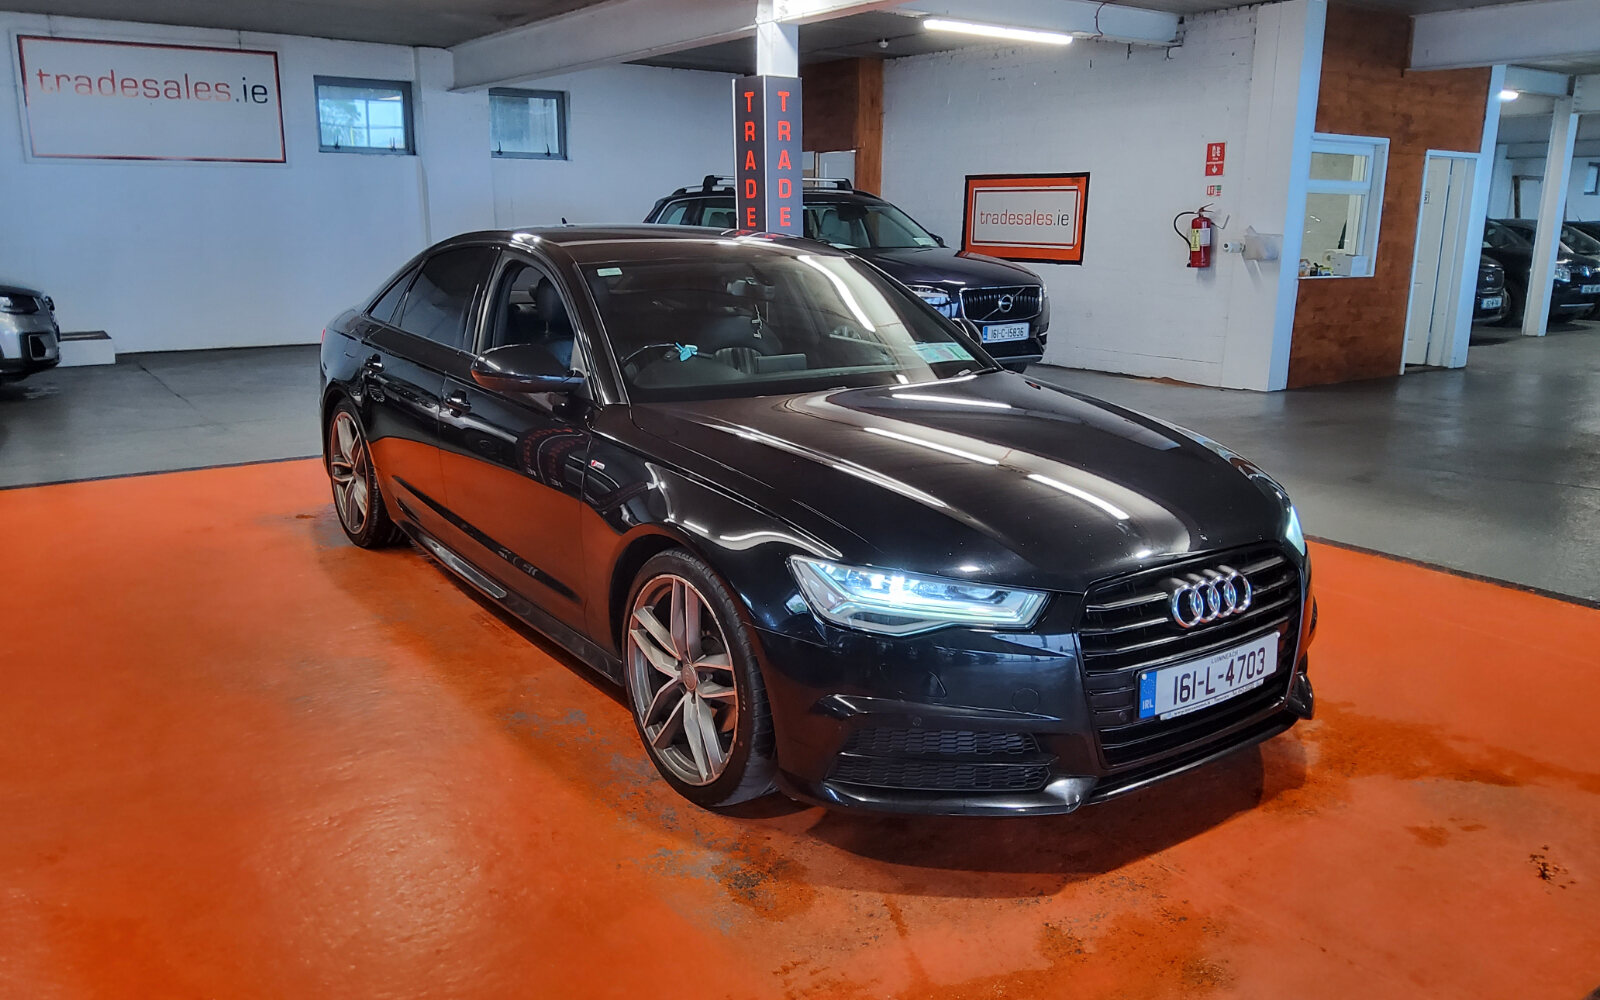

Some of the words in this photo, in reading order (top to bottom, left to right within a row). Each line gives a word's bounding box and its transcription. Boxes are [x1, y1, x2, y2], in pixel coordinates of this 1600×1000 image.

[36, 68, 269, 104] tradesales.ie
[744, 91, 757, 227] TRADE
[777, 91, 792, 227] TRADE
[980, 209, 1070, 226] tradesales.ie
[1173, 647, 1266, 705] 161-L-4703
[1142, 699, 1154, 710] IRL
